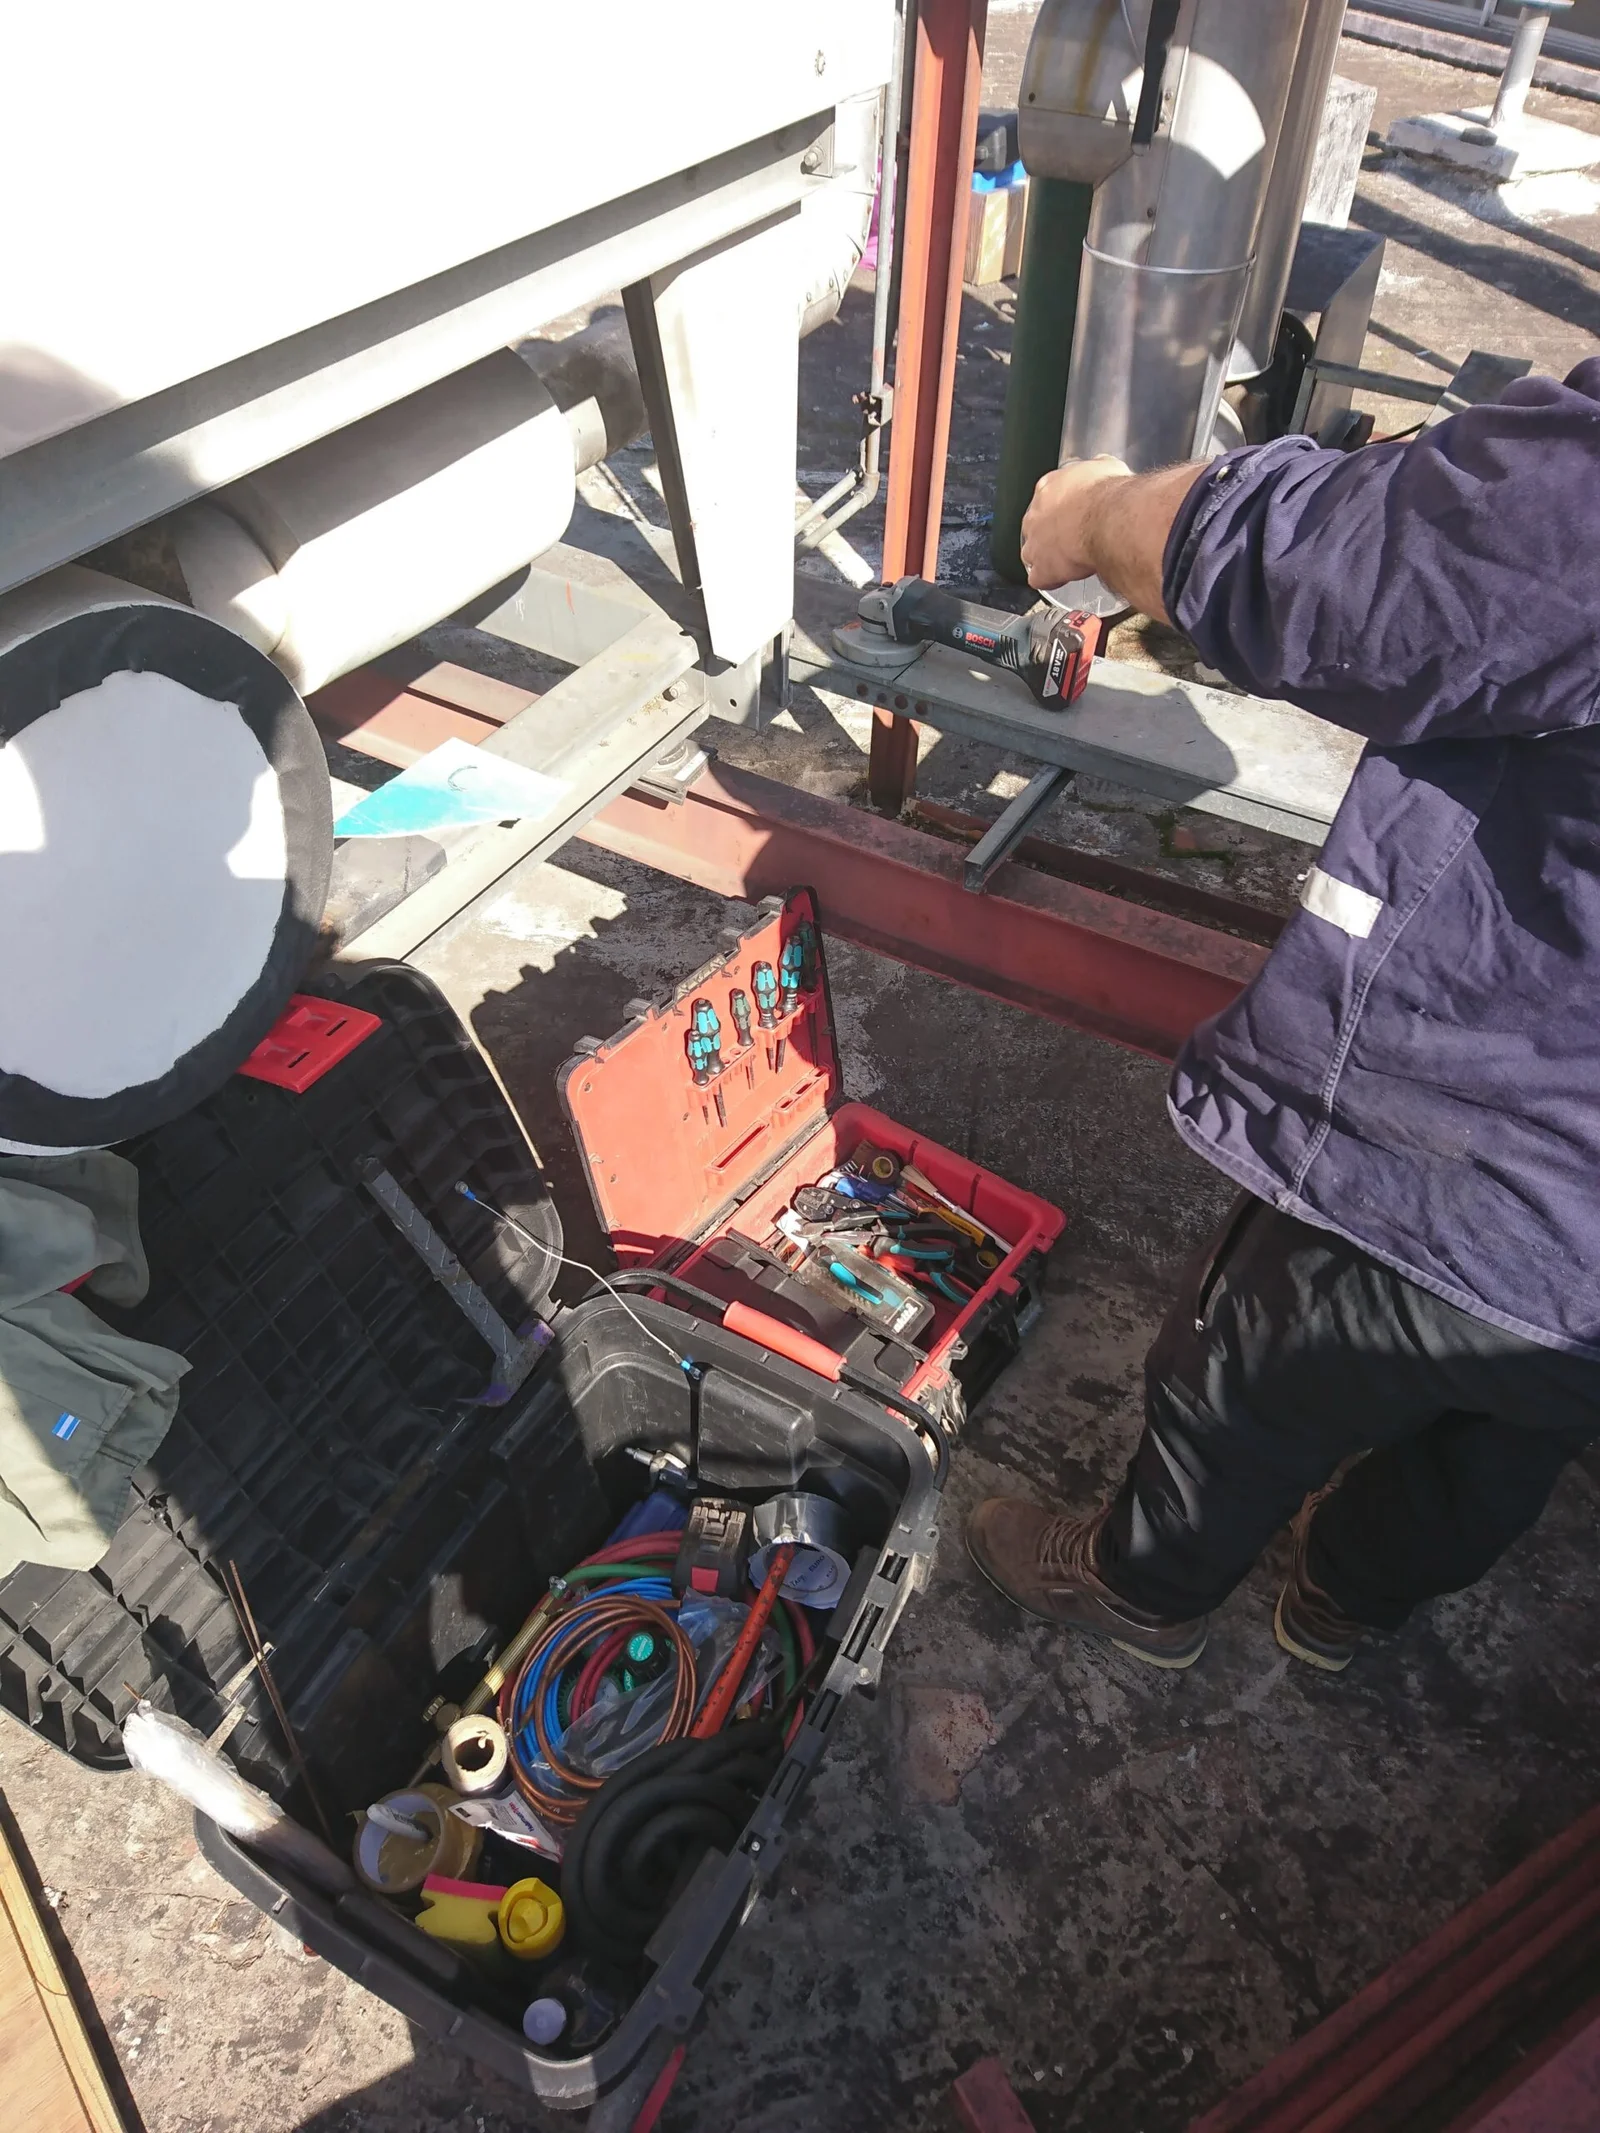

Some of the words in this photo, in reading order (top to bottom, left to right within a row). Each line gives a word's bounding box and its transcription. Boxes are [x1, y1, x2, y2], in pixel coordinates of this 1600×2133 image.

[964, 640, 994, 653] Professional
[965, 632, 995, 648] BOSCH
[1051, 659, 1060, 678] 18V
